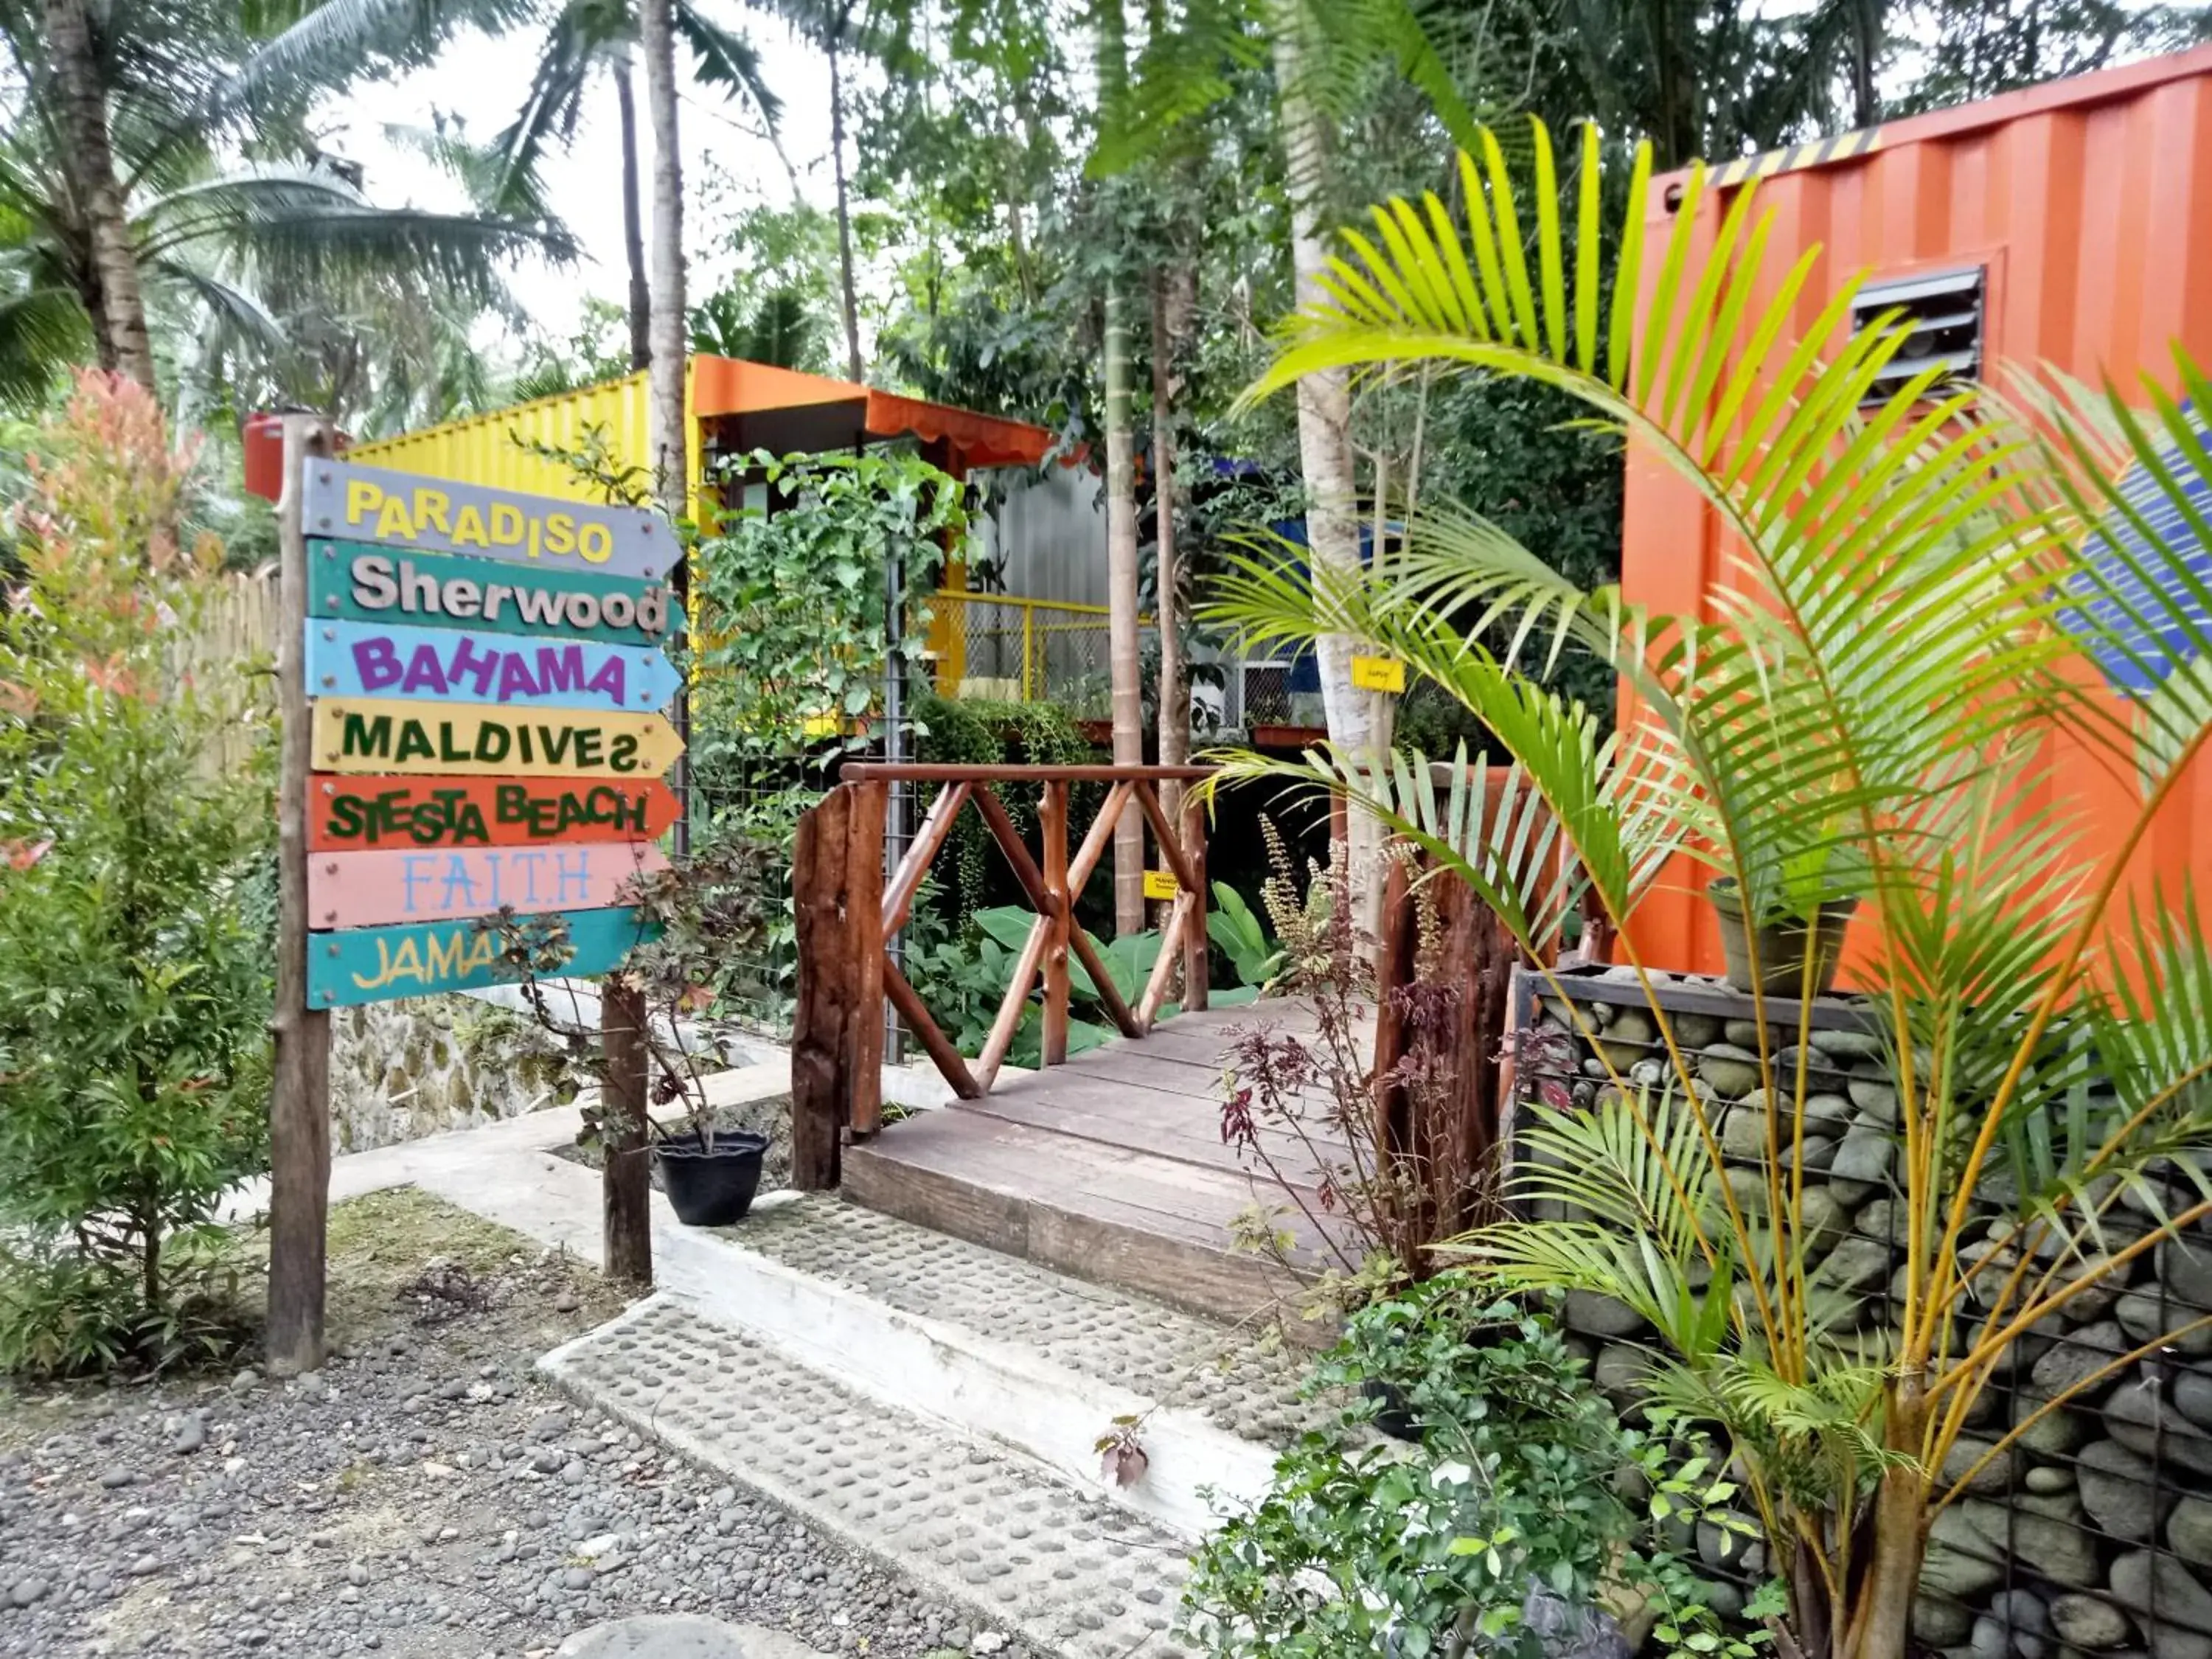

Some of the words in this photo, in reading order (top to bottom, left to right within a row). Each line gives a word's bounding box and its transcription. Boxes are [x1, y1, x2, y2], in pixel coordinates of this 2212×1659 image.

[346, 480, 612, 563] PARADISO
[351, 554, 668, 633] Sherwood
[352, 636, 625, 706] BAHAMA
[342, 712, 639, 773] MALDIVES
[327, 789, 490, 844] SIESTA
[496, 784, 647, 838] BEACH
